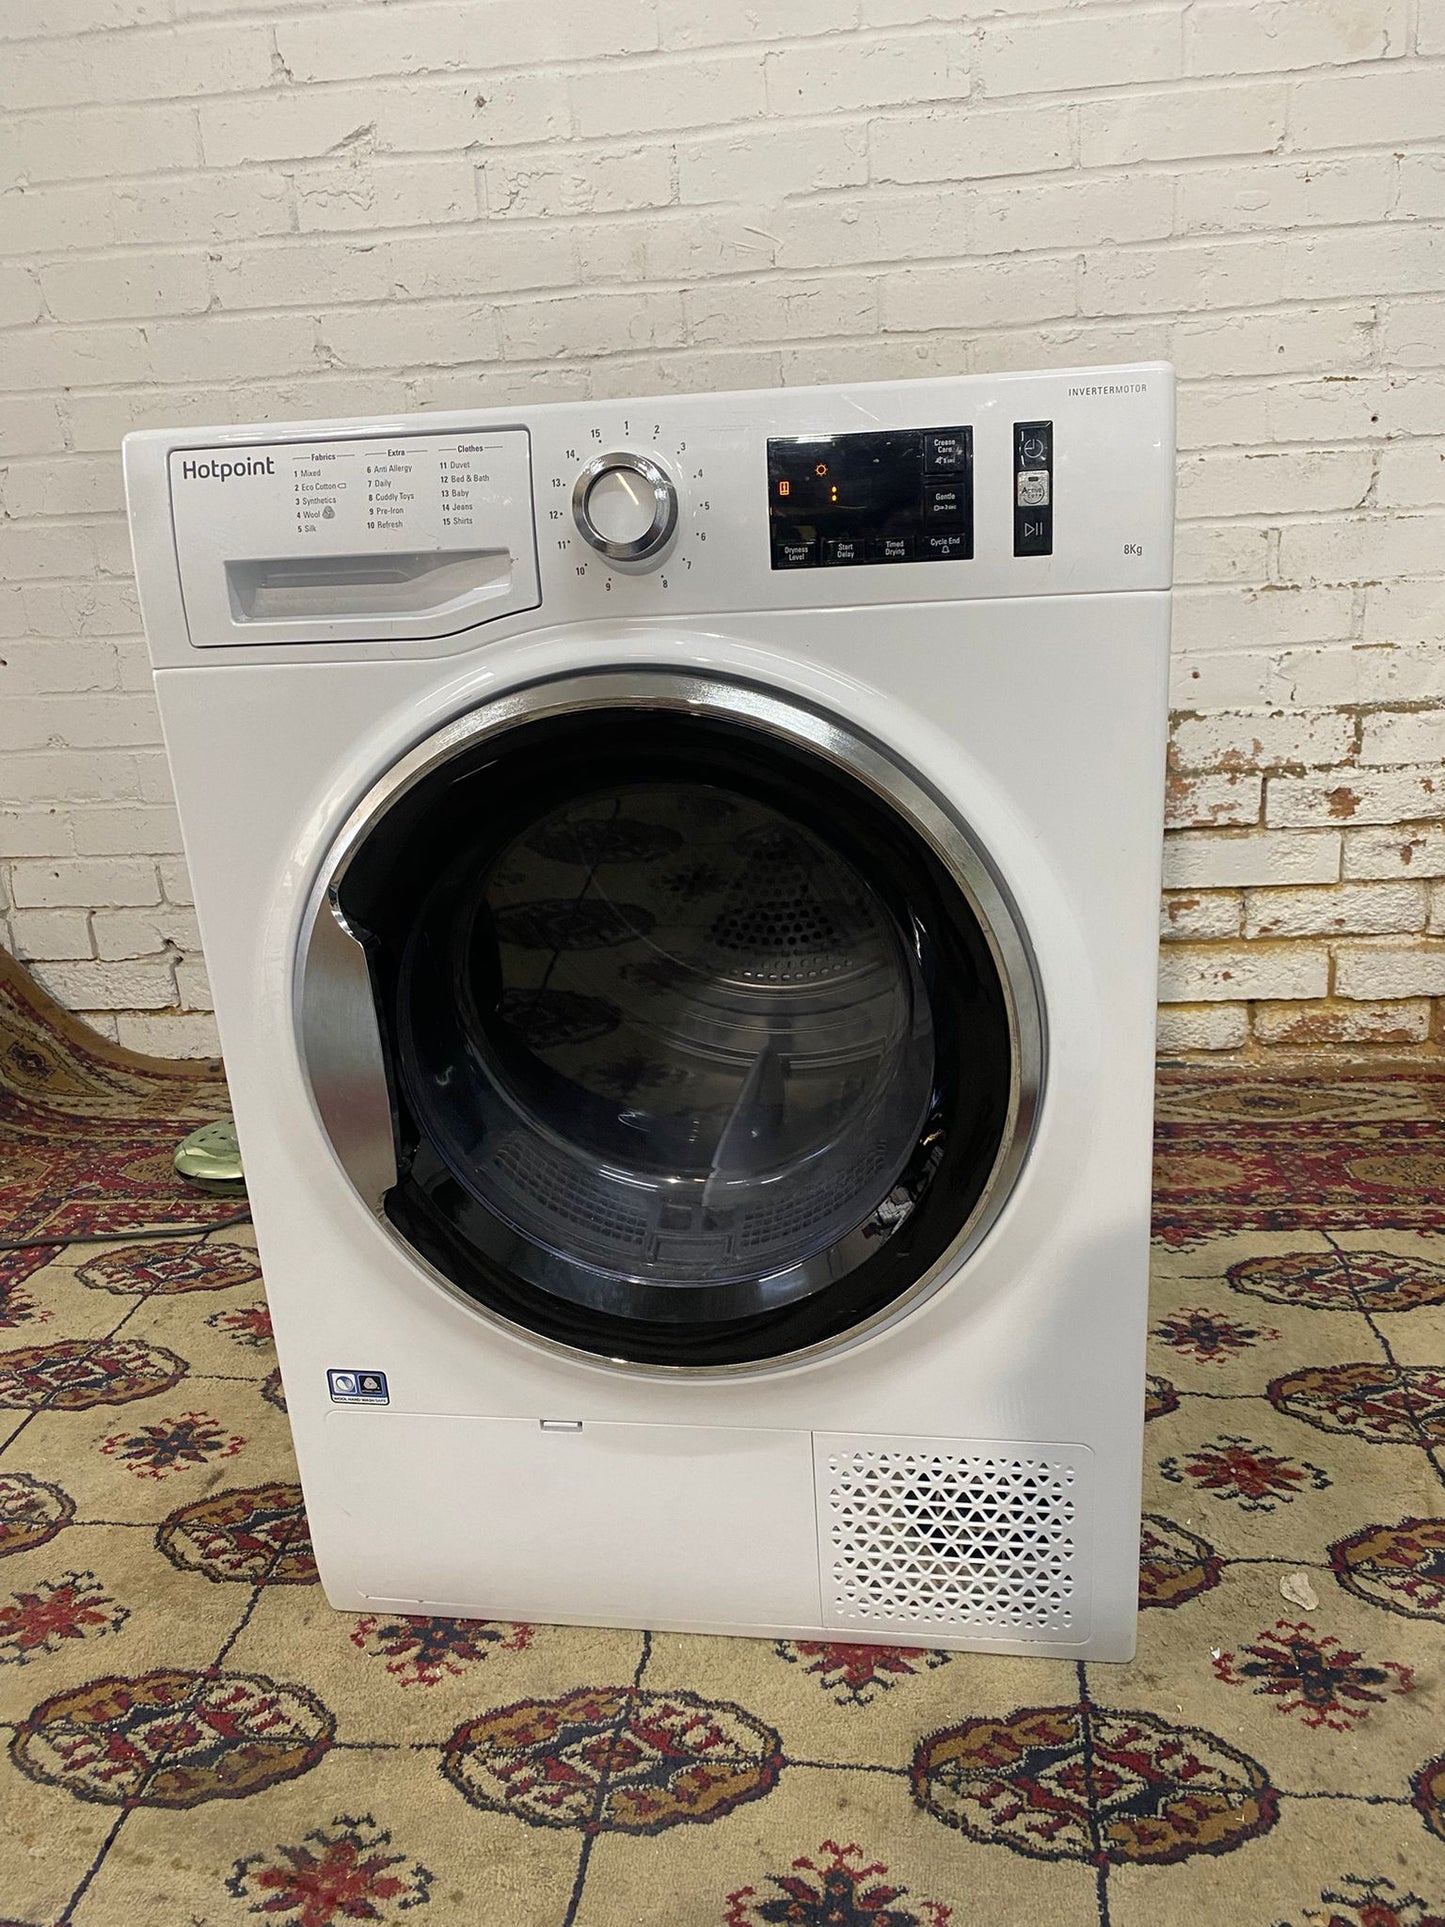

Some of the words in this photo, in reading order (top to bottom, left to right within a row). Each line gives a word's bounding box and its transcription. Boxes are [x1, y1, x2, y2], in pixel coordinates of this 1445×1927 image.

[654, 425, 660, 433] 2
[183, 457, 275, 482] Hotpoint
[389, 464, 412, 473] Allergy
[376, 493, 398, 502] Cuddly
[452, 489, 469, 498] Baby
[303, 497, 336, 506] Synthetics
[931, 538, 947, 546] Cycle
[886, 548, 905, 556] Drying
[1124, 544, 1142, 556] 8Kg
[837, 551, 854, 559] Delay
